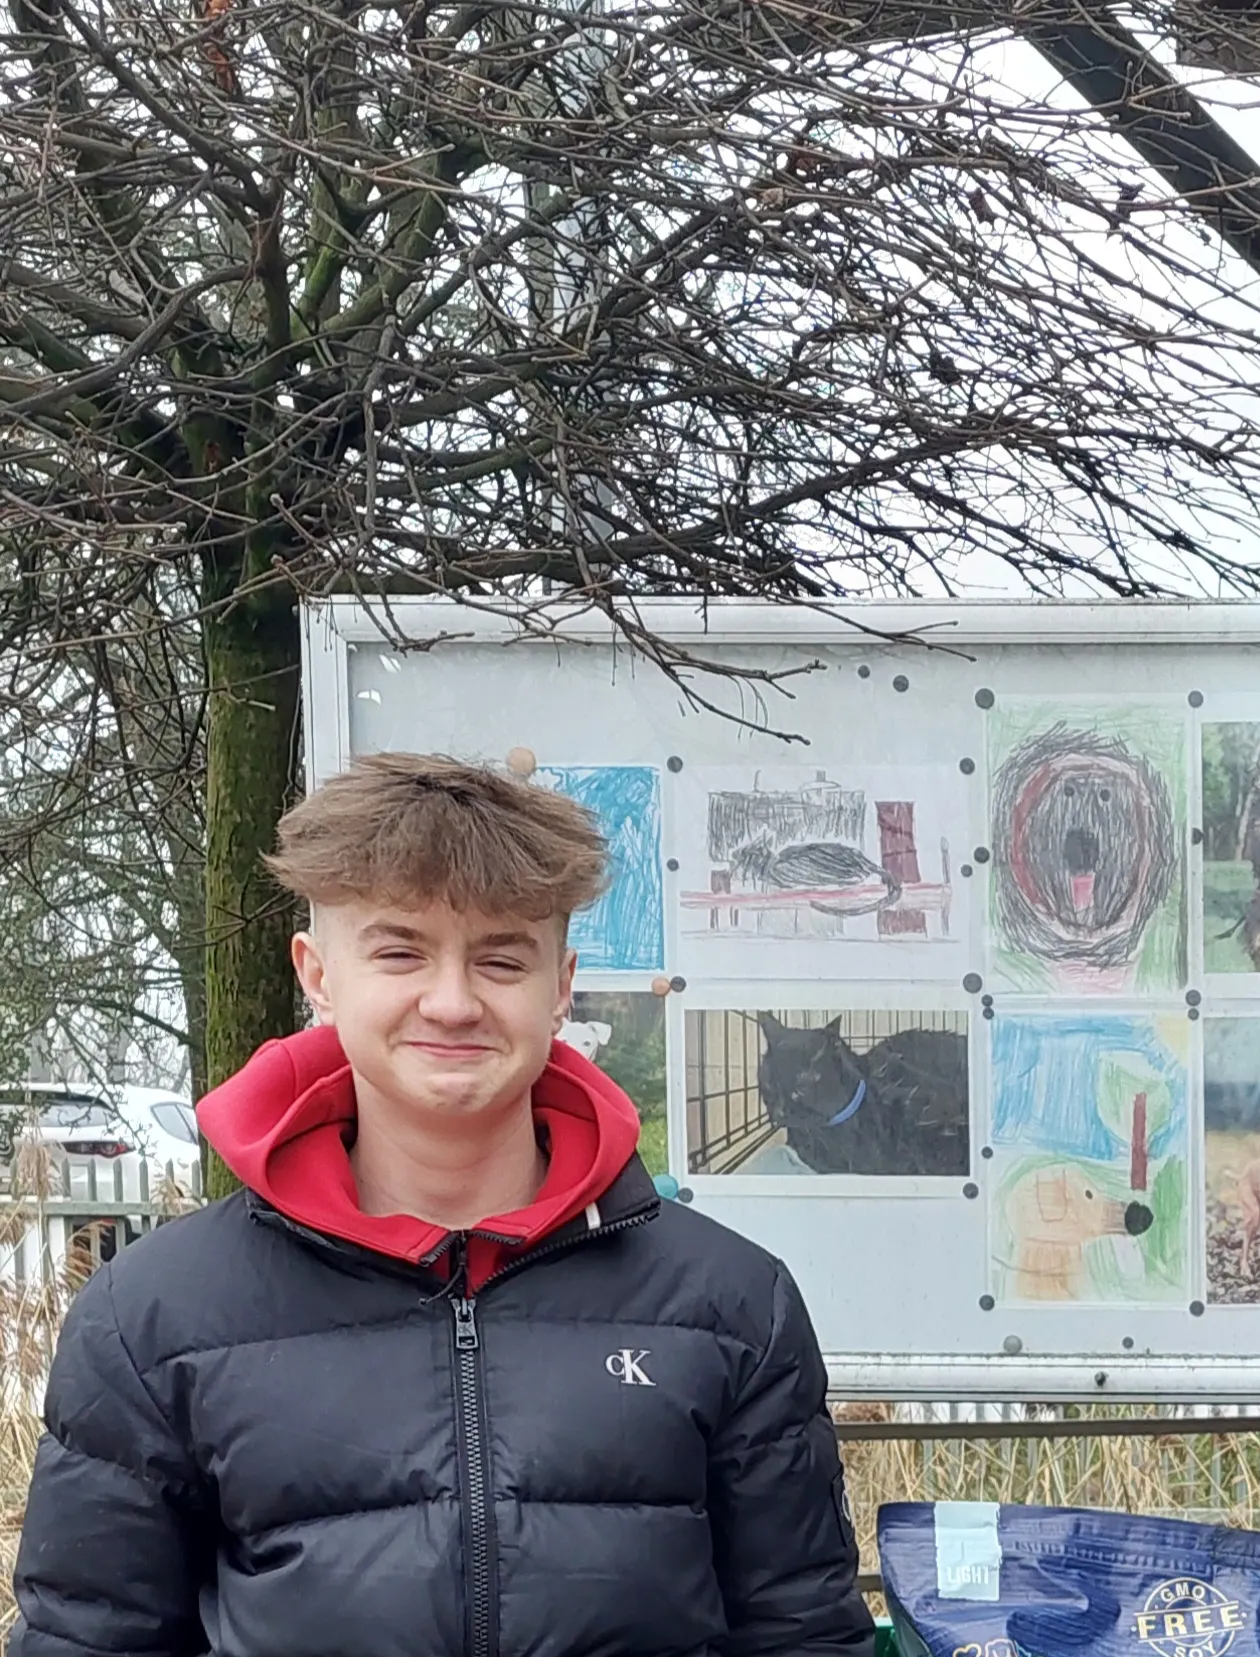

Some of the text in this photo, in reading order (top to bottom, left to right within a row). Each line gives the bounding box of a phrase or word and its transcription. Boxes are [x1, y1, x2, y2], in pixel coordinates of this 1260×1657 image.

[946, 1565, 989, 1585] LIGHT
[1160, 1582, 1206, 1602] GMO
[1137, 1605, 1243, 1639] FREE
